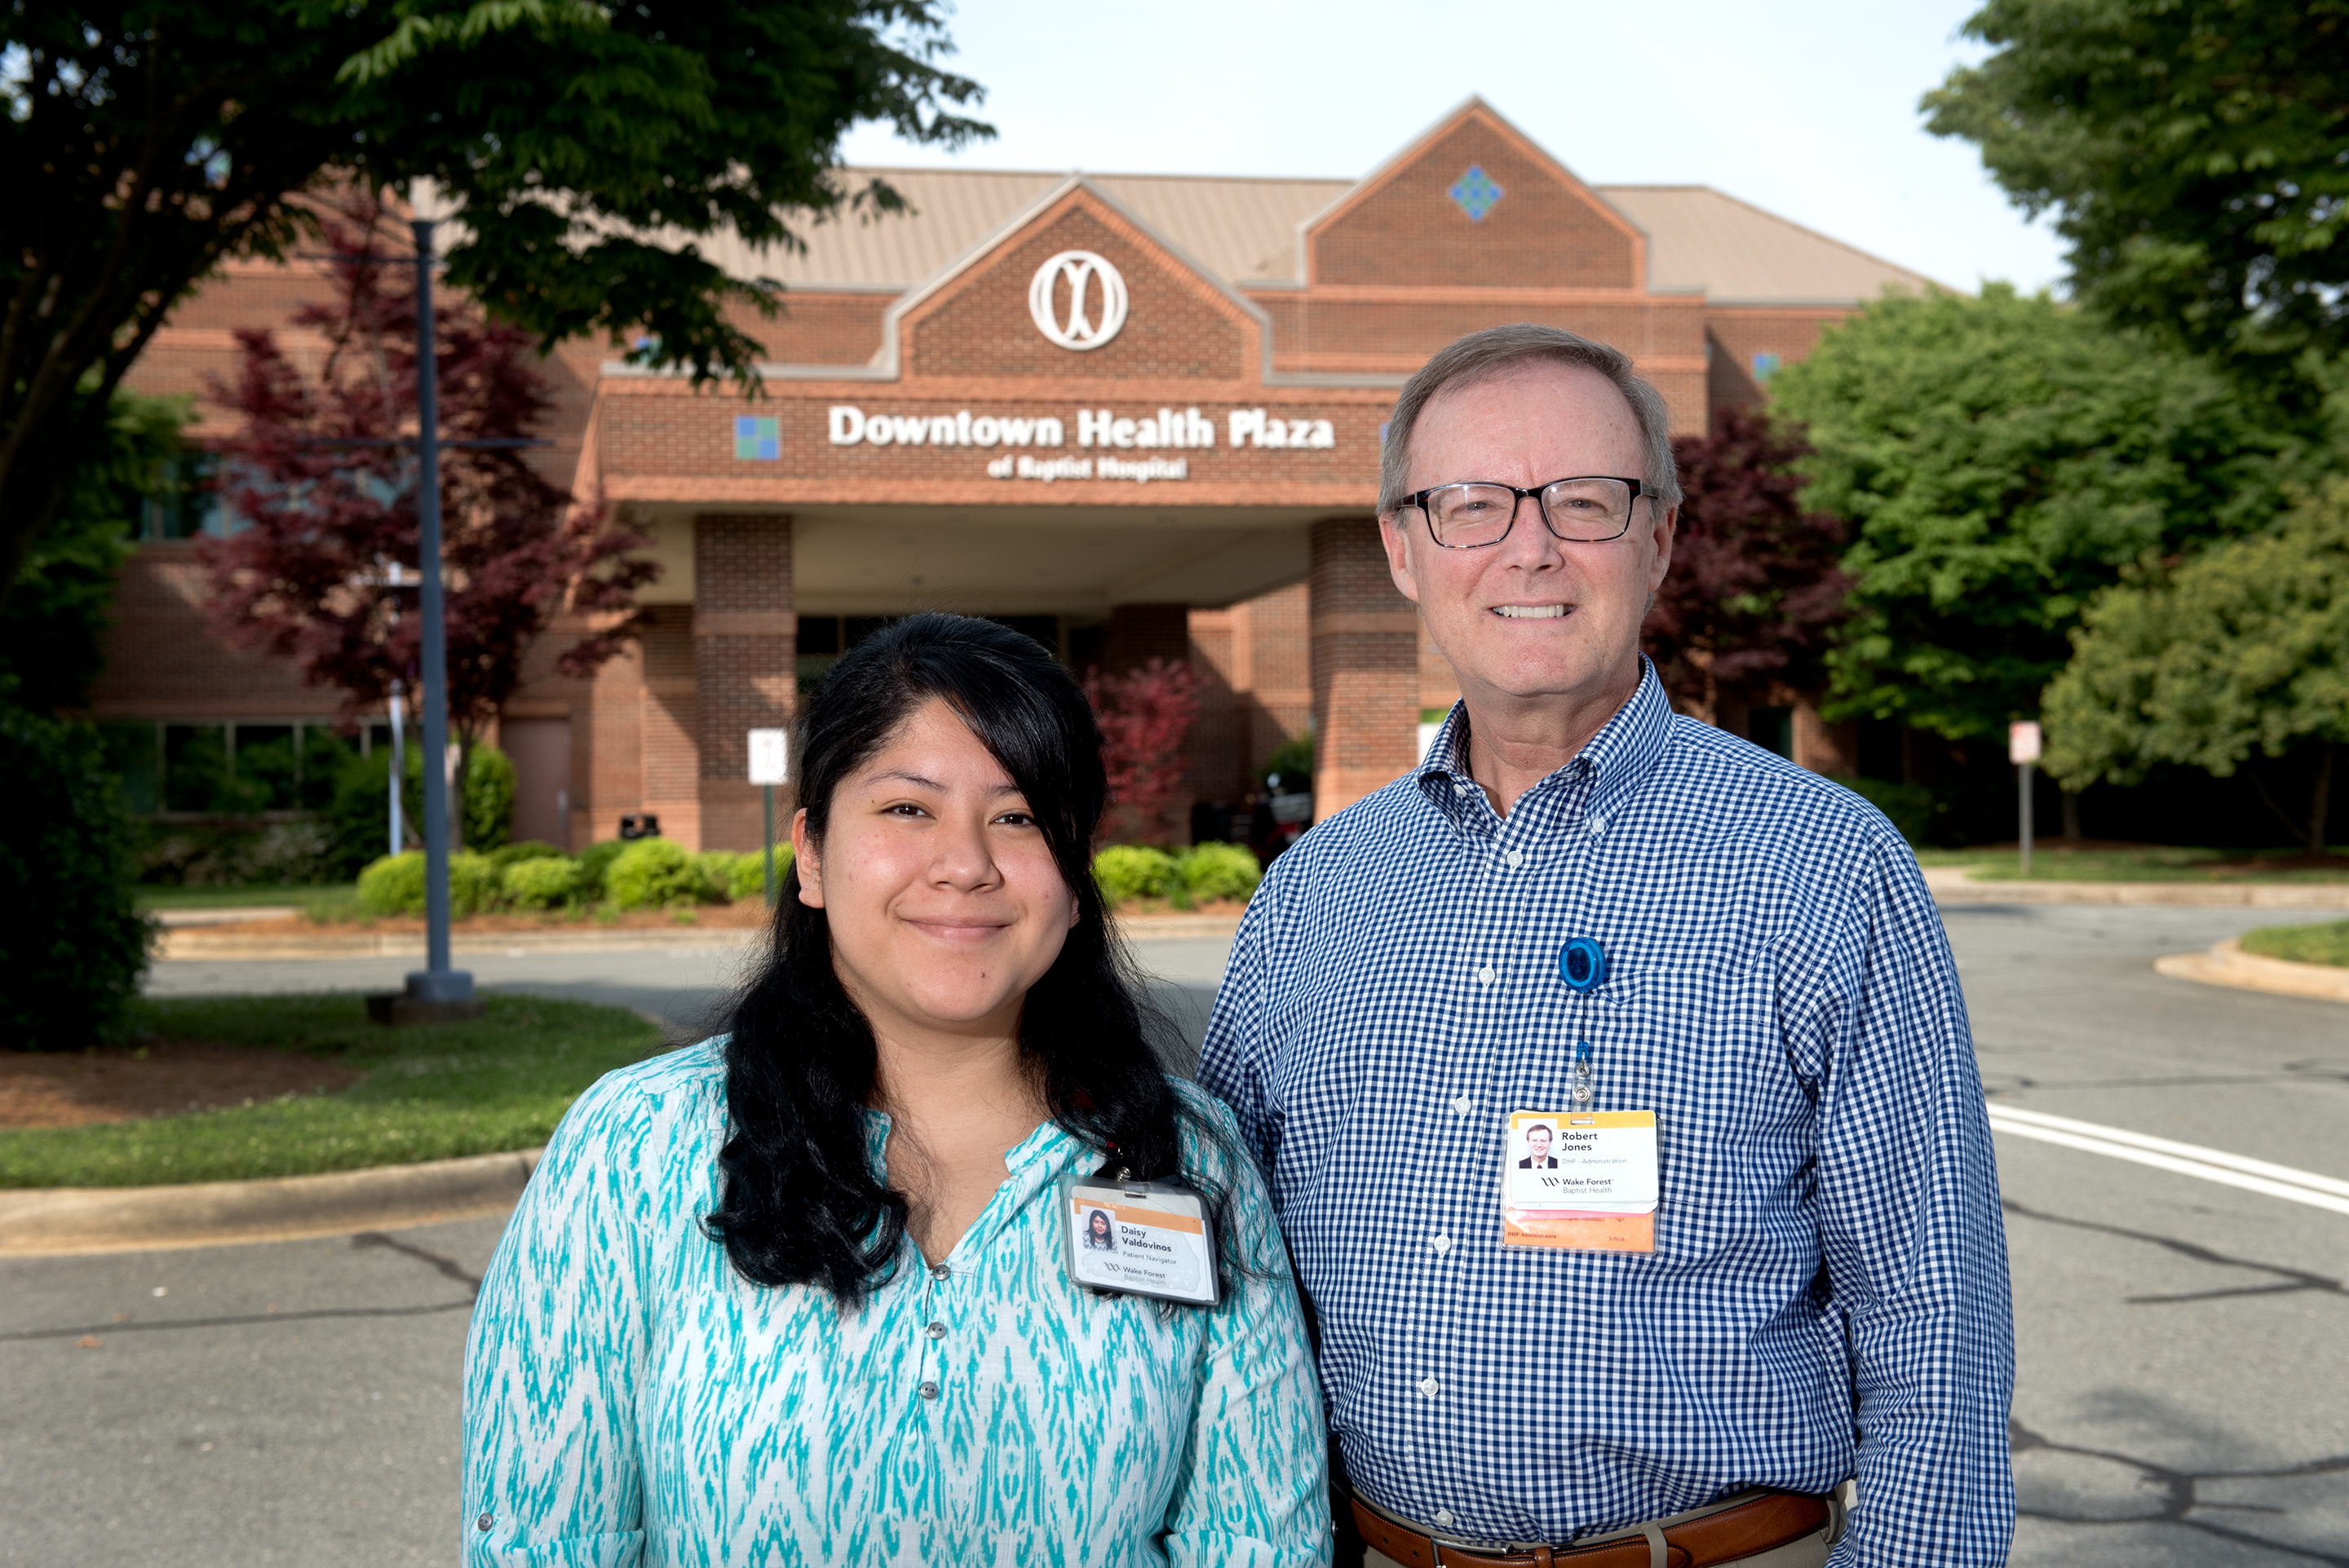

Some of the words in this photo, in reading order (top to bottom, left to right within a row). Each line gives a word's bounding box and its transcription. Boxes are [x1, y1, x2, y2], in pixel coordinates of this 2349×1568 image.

[829, 405, 1062, 446] Downtown
[1077, 408, 1214, 448] Health
[1228, 409, 1335, 448] Plaza
[987, 453, 1014, 479] of
[1017, 455, 1093, 484] Baptist
[1097, 455, 1188, 484] Hospital
[1562, 1132, 1598, 1140] Robert
[1563, 1186, 1587, 1195] Baptist
[1121, 1226, 1146, 1239] Daisy
[1121, 1237, 1171, 1252] Valdovinos
[1123, 1251, 1144, 1260] Patient
[1146, 1255, 1176, 1264] Navigator
[1123, 1266, 1142, 1274] Wake
[1144, 1270, 1166, 1279] Forest
[1124, 1274, 1144, 1283] Baptist
[1147, 1278, 1166, 1286] Health
